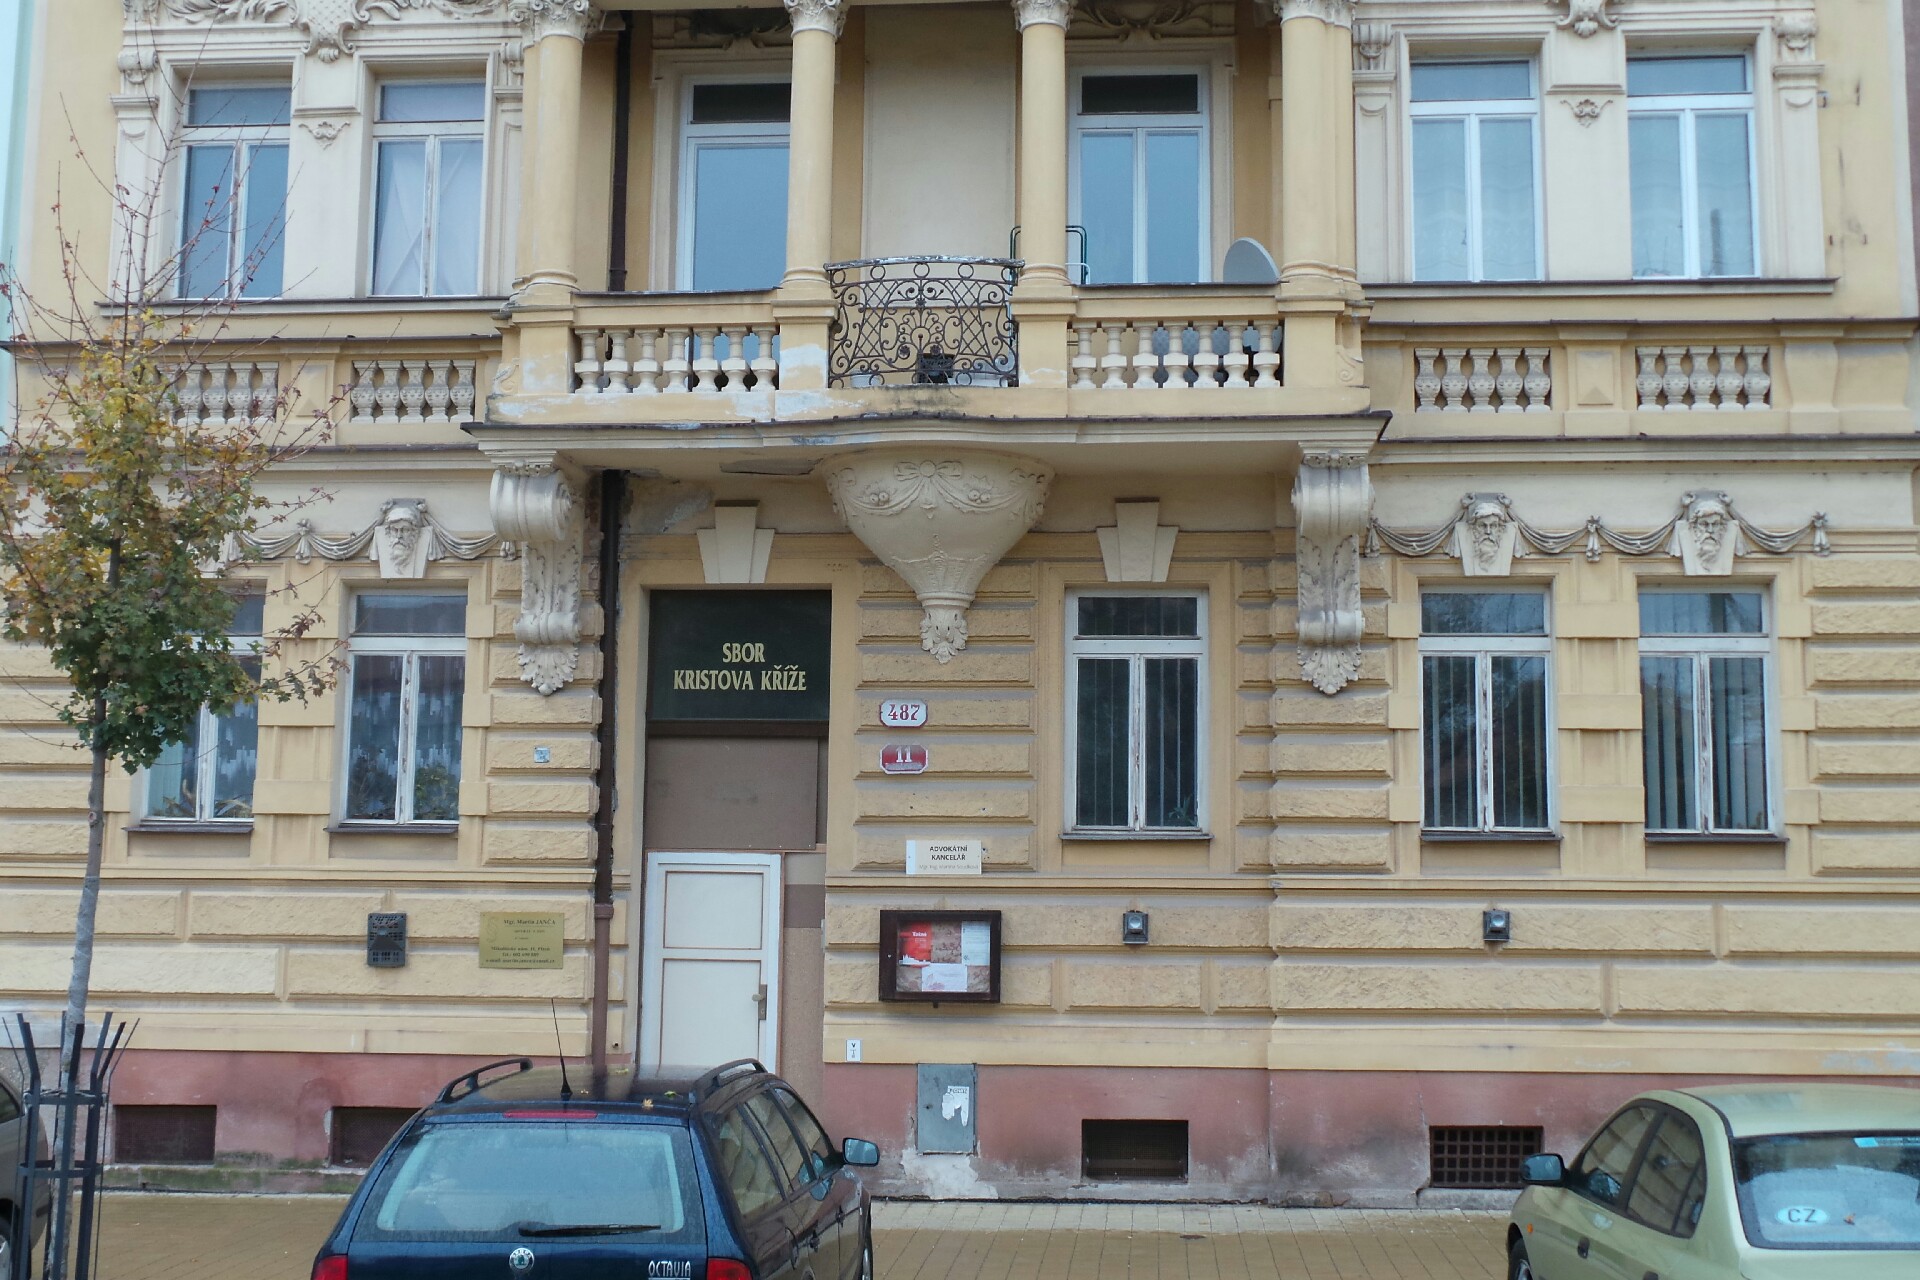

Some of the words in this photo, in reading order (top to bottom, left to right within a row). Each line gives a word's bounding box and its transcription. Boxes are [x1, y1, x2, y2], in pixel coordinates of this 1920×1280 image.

[722, 643, 766, 663] SBOR
[673, 669, 755, 691] KRISTOVA
[760, 664, 807, 691] KŘÍŽE
[888, 703, 921, 721] 487
[896, 744, 913, 763] 11
[929, 844, 968, 852] ADVOKÁTNÍ
[931, 853, 966, 861] KANCELÁŘ
[1787, 1208, 1817, 1223] CZ
[648, 1260, 692, 1277] OCTAVIA
